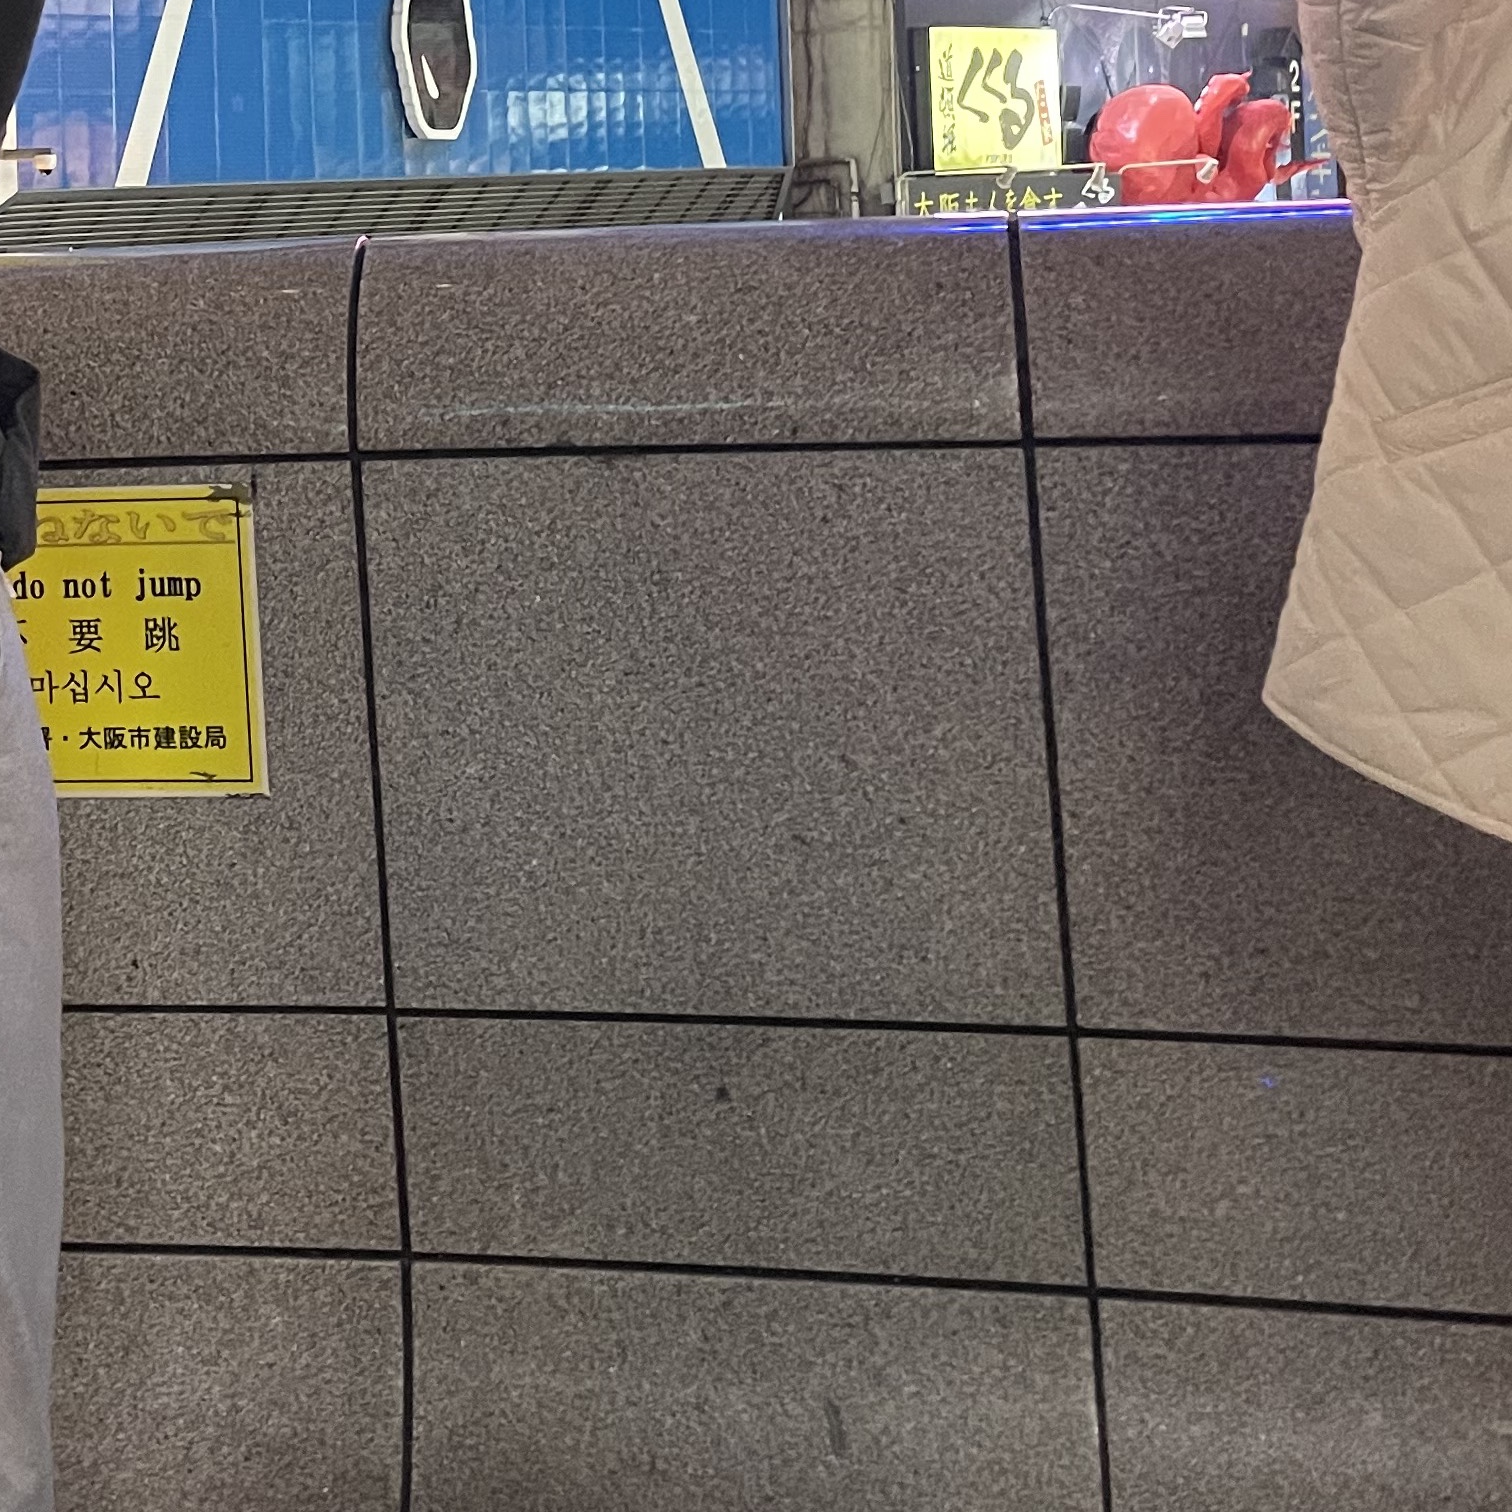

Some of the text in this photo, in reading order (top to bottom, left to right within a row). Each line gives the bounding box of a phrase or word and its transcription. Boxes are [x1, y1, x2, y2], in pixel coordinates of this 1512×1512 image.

[14, 568, 202, 602] do not jump
